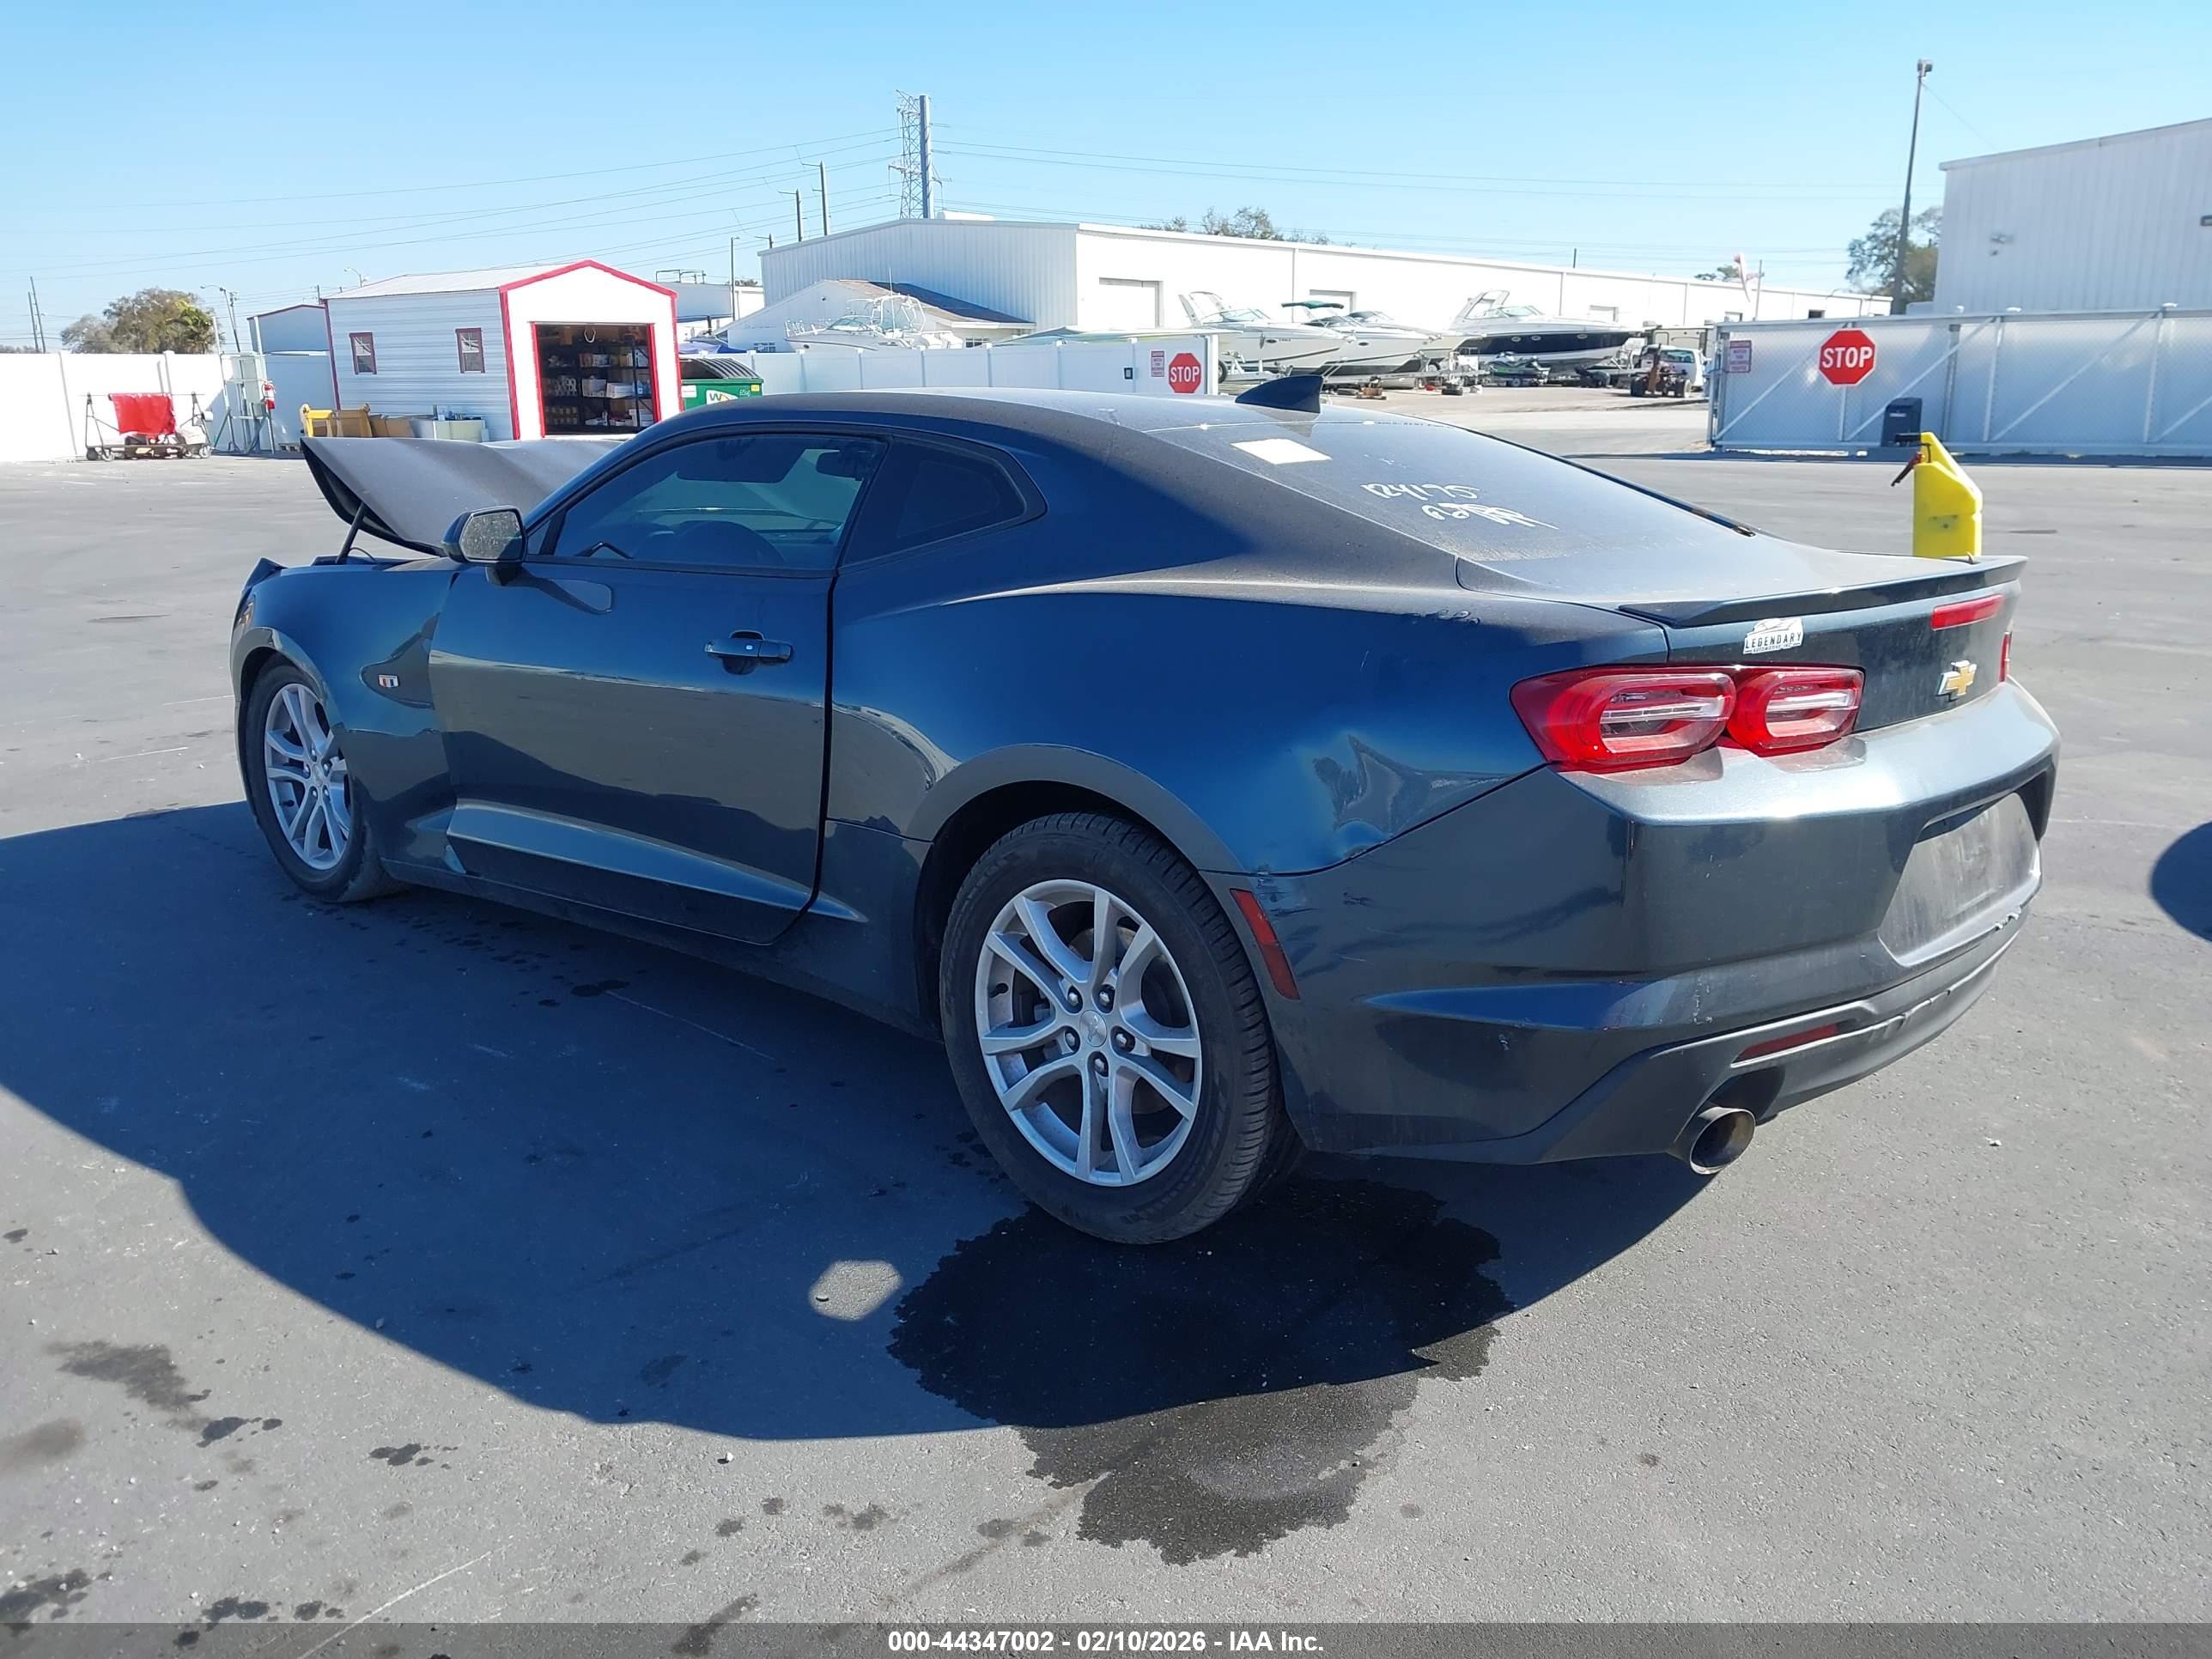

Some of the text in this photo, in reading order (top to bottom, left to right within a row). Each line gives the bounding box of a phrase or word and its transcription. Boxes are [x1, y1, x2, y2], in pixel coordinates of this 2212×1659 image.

[1821, 346, 1873, 368] STOP
[1170, 366, 1200, 383] STOP
[1745, 631, 1802, 649] LEGENDARY
